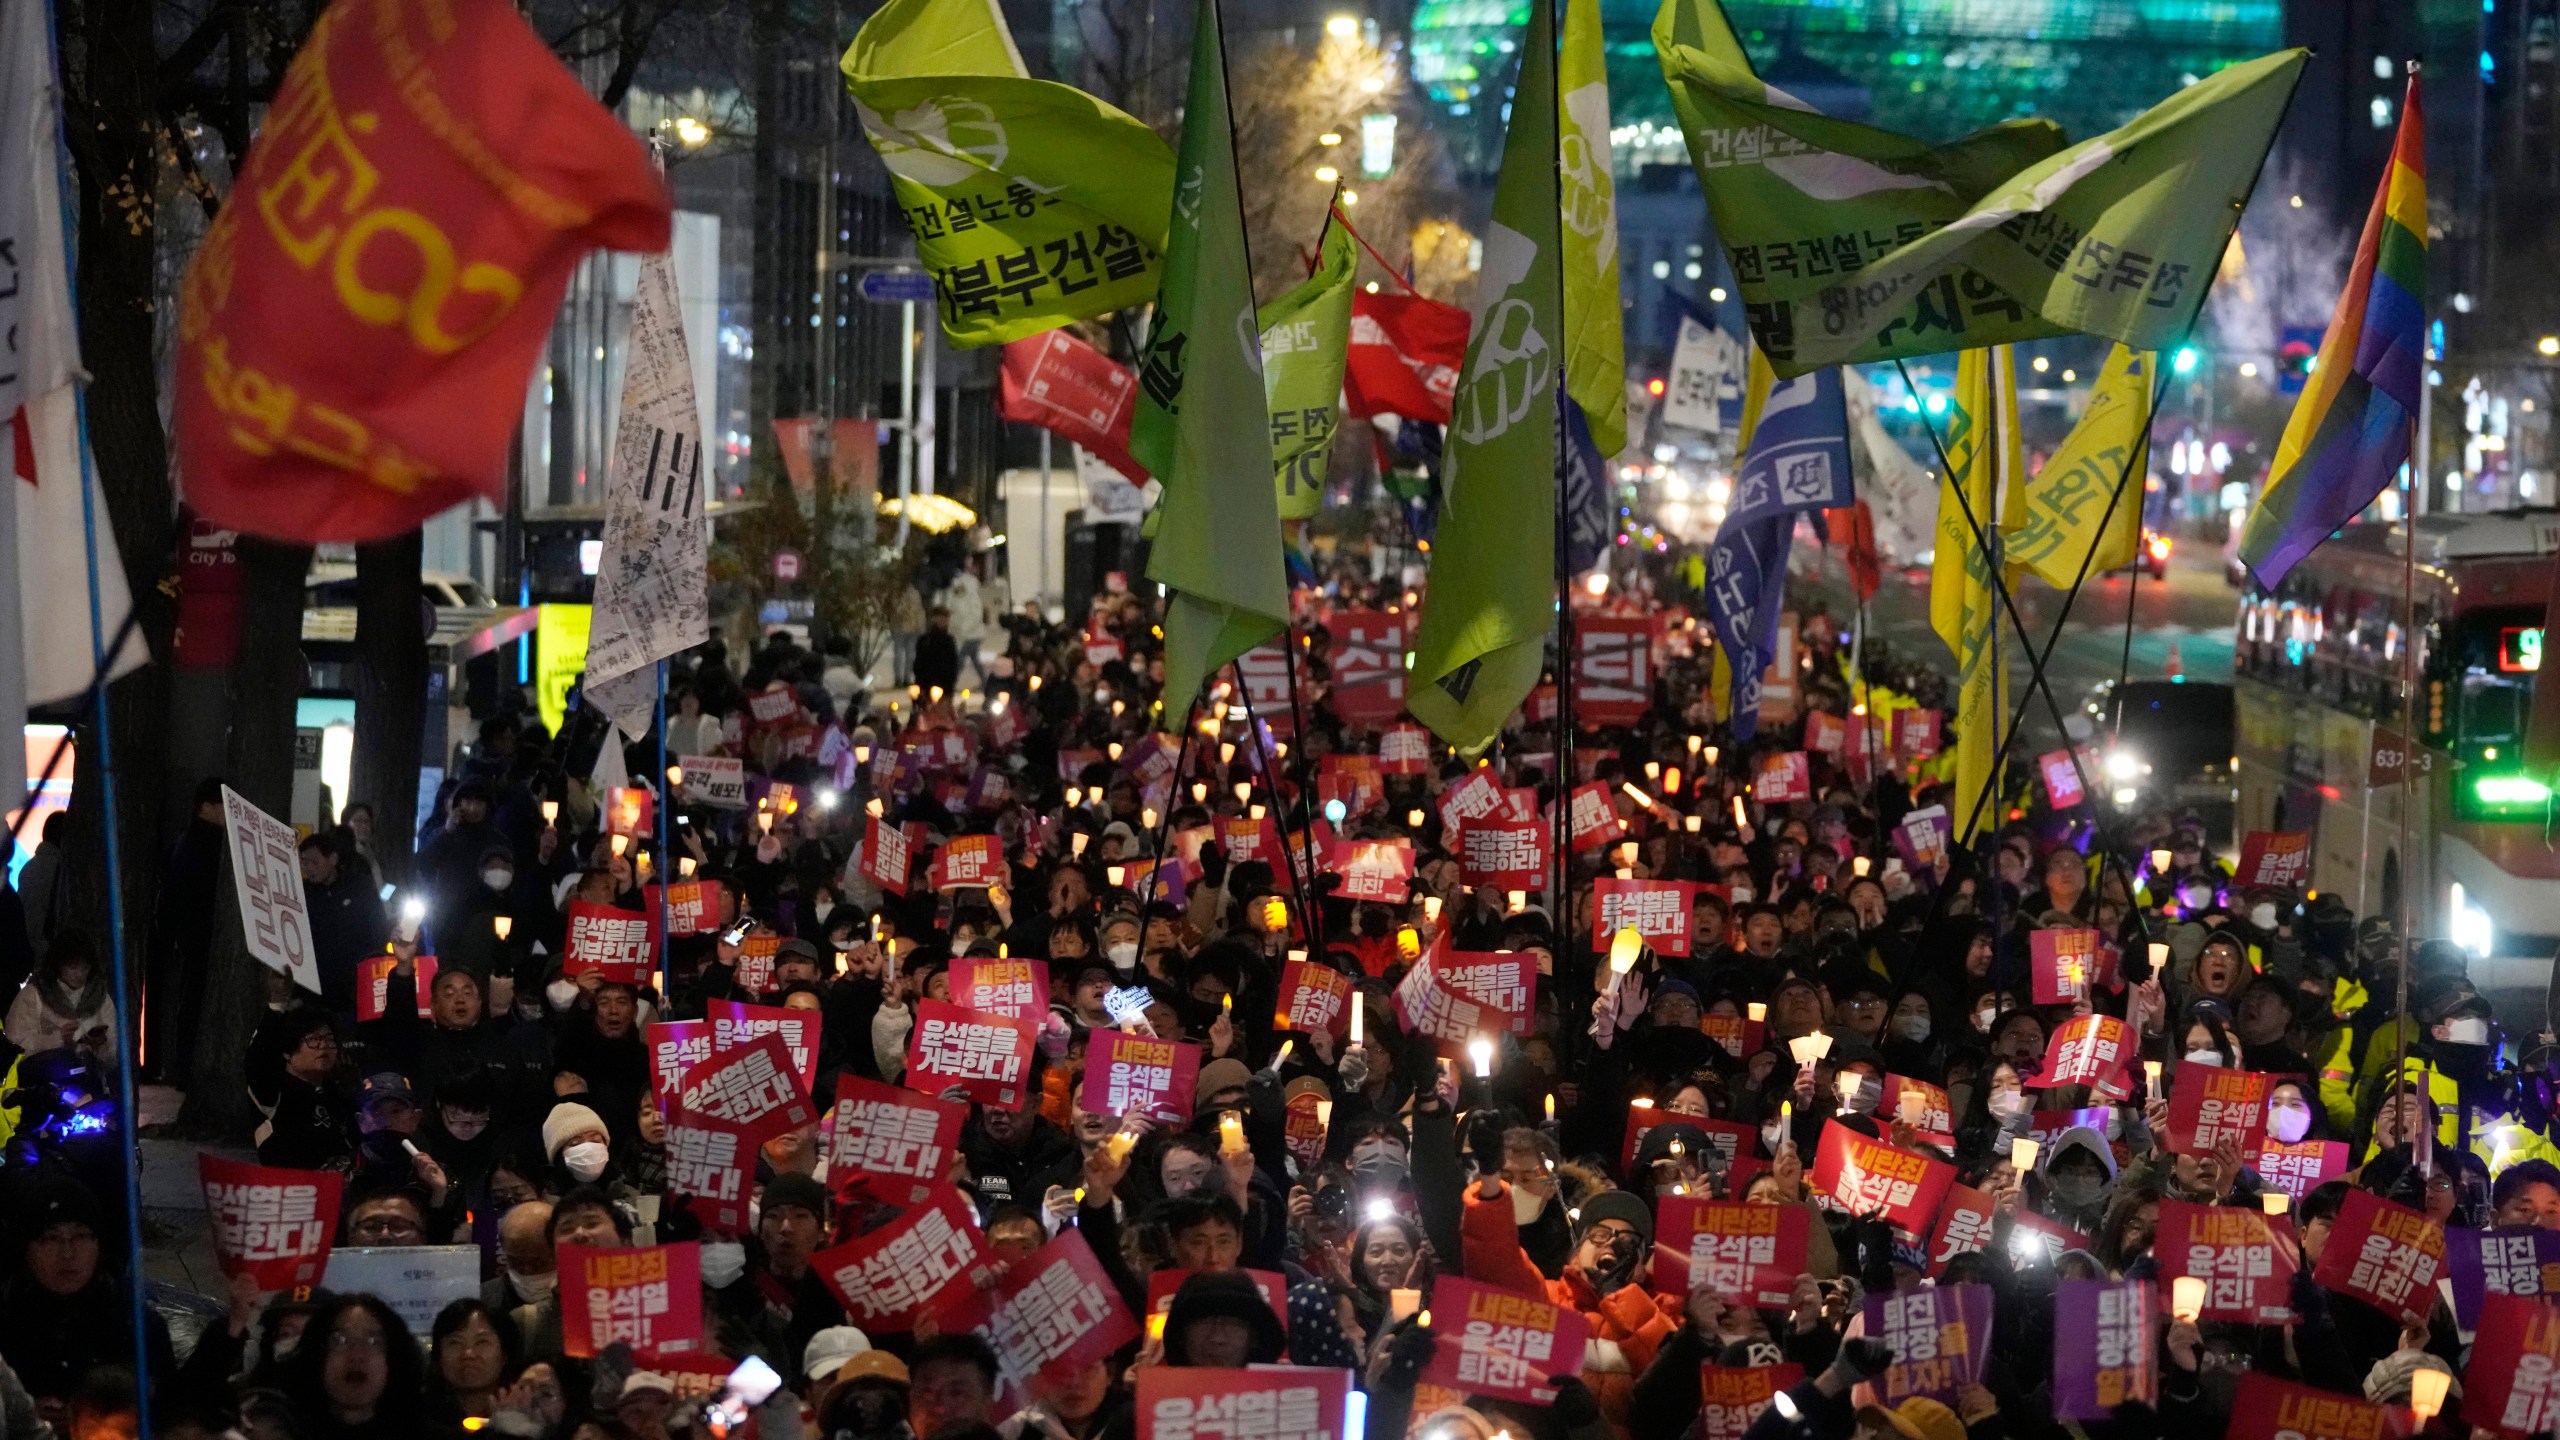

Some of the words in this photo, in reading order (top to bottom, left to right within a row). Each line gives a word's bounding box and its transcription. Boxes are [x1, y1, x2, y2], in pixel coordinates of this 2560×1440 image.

[1465, 827, 1539, 852] 국정농단
[946, 849, 989, 870] 윤석열
[946, 863, 981, 881] 퇴진!
[1464, 847, 1542, 873] 규명하라!
[1346, 876, 1385, 895] 퇴진!
[1601, 889, 1682, 918] 윤석열을
[572, 914, 649, 942] 윤석열을
[569, 937, 653, 965] 거부한다!
[972, 961, 1032, 986] 내란죄
[973, 982, 1033, 1007] 윤석열
[1293, 984, 1343, 1018] 윤석열
[1289, 1005, 1330, 1030] 퇴진!
[922, 1018, 1019, 1056] 윤석열을
[1111, 1038, 1176, 1068] 내란죄
[916, 1044, 1022, 1083] 거부한다!
[1109, 1062, 1173, 1091] 윤석열
[2050, 1057, 2100, 1084] 퇴진!
[1109, 1085, 1155, 1112] 퇴진!
[2204, 1072, 2265, 1101] 내란죄
[837, 1098, 940, 1147] 윤석열을
[2198, 1096, 2262, 1129] 윤석열
[831, 1130, 942, 1180] 거부한다!
[1852, 1141, 1931, 1185] 내란죄
[2258, 1152, 2322, 1180] 윤석열
[981, 1177, 1008, 1185] TEAM
[1840, 1161, 1919, 1209] 윤석열
[1692, 1206, 1779, 1236] 내란죄
[2188, 1212, 2269, 1246] 내란죄
[2369, 1206, 2447, 1259] 내란죄
[833, 1206, 954, 1302] 윤석열을
[1689, 1232, 1777, 1267] 윤석열
[2186, 1244, 2273, 1279] 윤석열
[2360, 1233, 2440, 1285] 윤석열
[2480, 1235, 2538, 1267] 퇴진
[585, 1250, 668, 1287] 내란죄
[862, 1227, 979, 1321] 거부한다!
[1688, 1261, 1755, 1294] 퇴진!
[2347, 1260, 2414, 1306] 퇴진!
[586, 1280, 670, 1320] 윤석열
[2203, 1279, 2254, 1310] 진!
[1466, 1290, 1558, 1333] 내란죄
[1883, 1293, 1938, 1330] 퇴진
[1461, 1318, 1555, 1362] 윤석열
[1456, 1352, 1531, 1390] 퇴진!
[1153, 1386, 1320, 1440] 윤석열을
